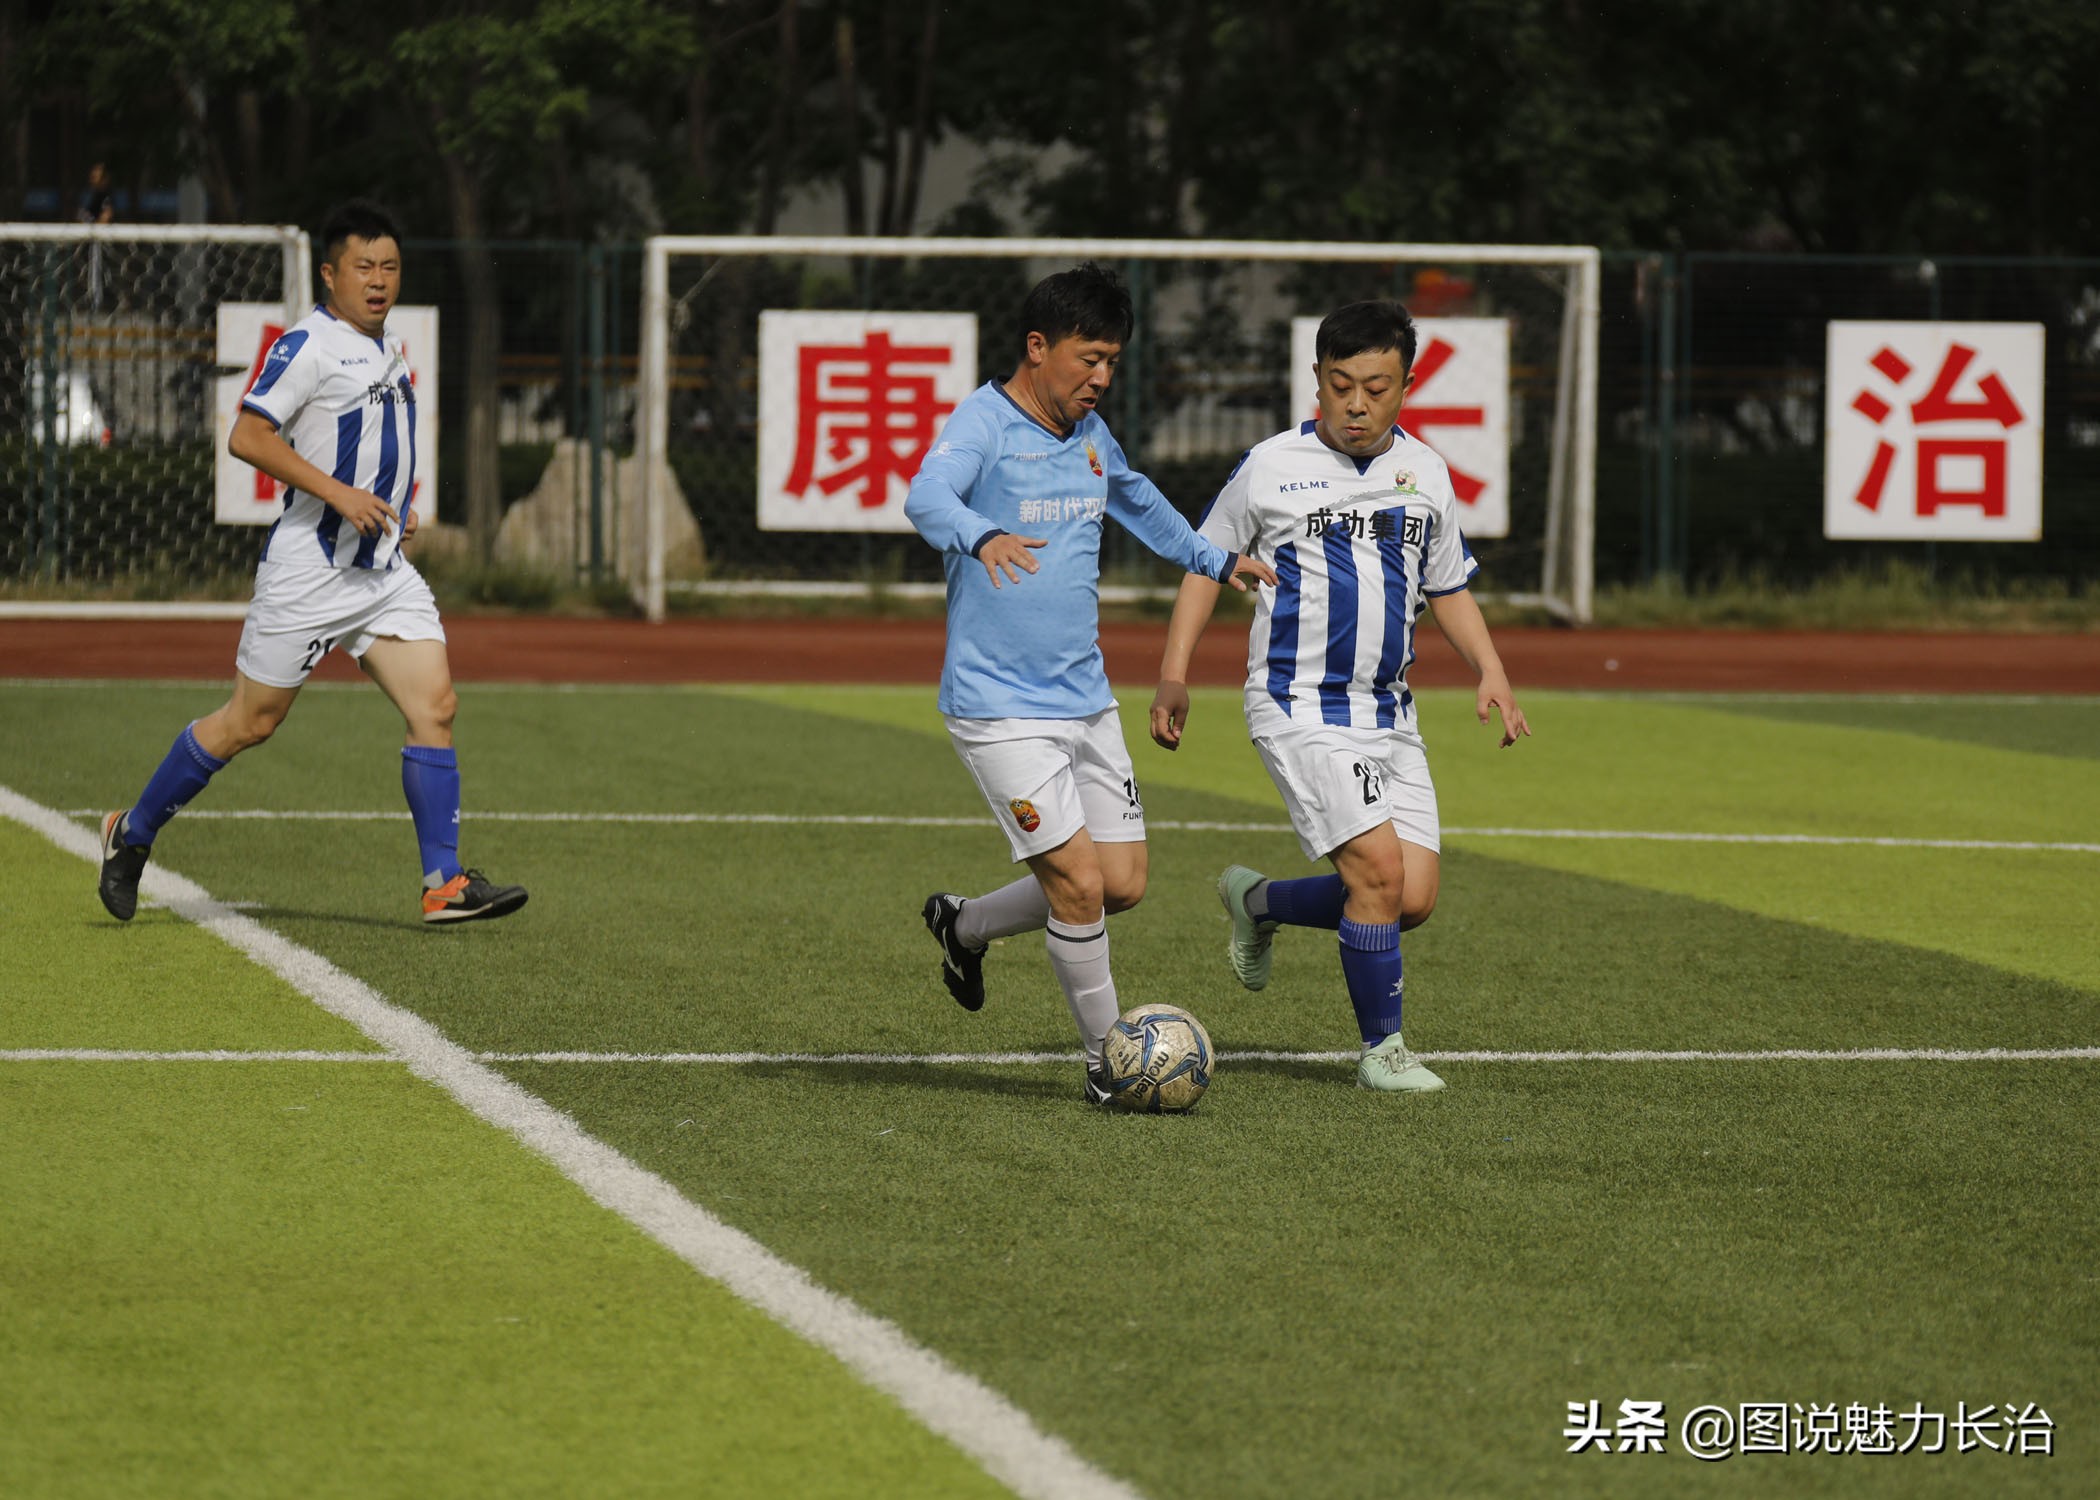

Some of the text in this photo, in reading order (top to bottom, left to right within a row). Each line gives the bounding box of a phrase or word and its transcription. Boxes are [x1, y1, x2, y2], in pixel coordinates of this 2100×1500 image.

[784, 330, 957, 509] 康
[1851, 343, 2025, 518] 治
[1279, 480, 1330, 493] KELME
[1019, 496, 1107, 523] 新时代双
[1305, 507, 1424, 548] 成功集团
[1132, 1051, 1169, 1099] molten
